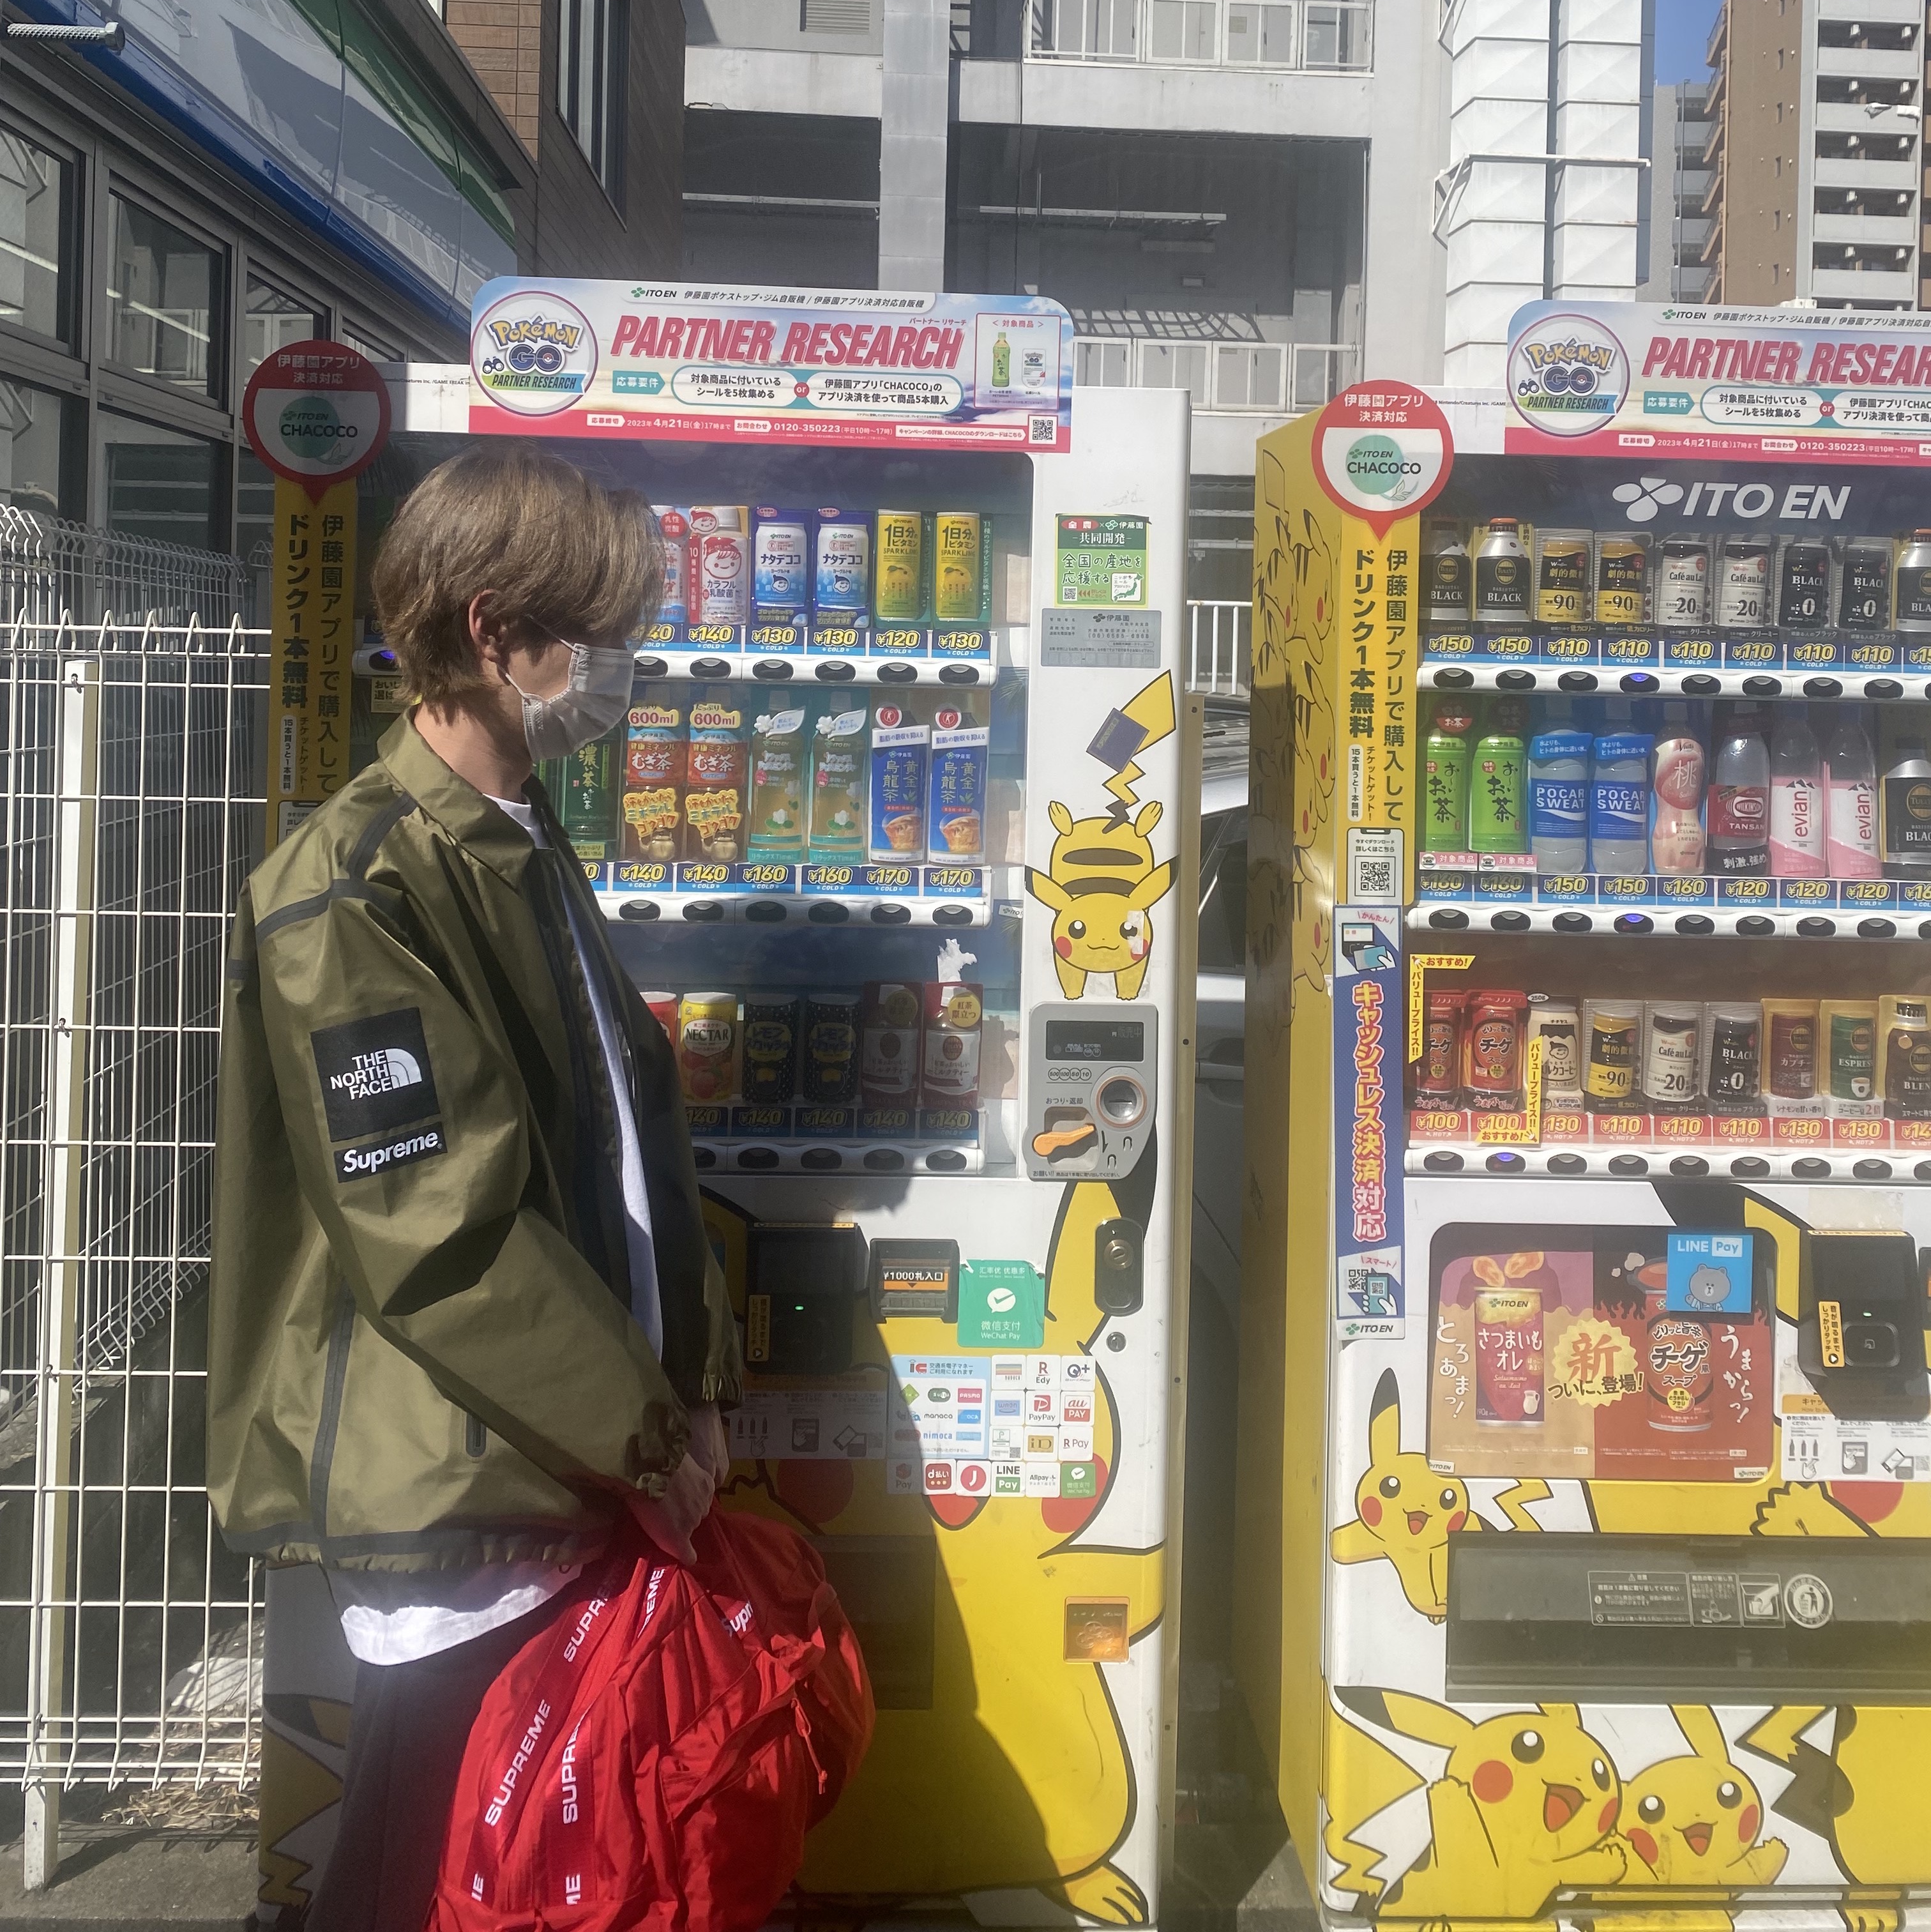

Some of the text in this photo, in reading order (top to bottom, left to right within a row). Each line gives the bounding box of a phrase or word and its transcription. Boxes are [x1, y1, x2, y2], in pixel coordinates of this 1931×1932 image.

[684, 290, 806, 304] 伊藤園ポケストップ・ジム自販機
[814, 295, 925, 308] 伊藤園アプリ決済対応自販機
[1713, 312, 1830, 324] 伊藤園ポケストップ・ジム自販機
[1838, 317, 1931, 328] 伊藤園アプリ決済対応自
[491, 316, 580, 347] Pokémon
[610, 315, 965, 370] PARTNER RESEARCH
[277, 354, 360, 369] 伊藤園アプリ
[509, 345, 563, 372] GO
[1526, 338, 1613, 370] Pokémon
[293, 372, 344, 384] 決済対応
[492, 374, 577, 390] PARTNER RESEARCH
[616, 376, 658, 388] 応募要件
[690, 373, 782, 386] 対象商品に付いている
[824, 379, 943, 392] 伊藤園アプリ「CHACOCO」の
[1543, 365, 1595, 393] GO
[697, 386, 775, 399] シールを5枚集める
[818, 392, 949, 405] アプリ決済を使って商品5本購入
[1344, 394, 1424, 407] 伊藤園アプリ
[1719, 393, 1807, 406] 対象商品に付いている
[1527, 395, 1609, 410] PARTNER RESEARCH
[1647, 397, 1688, 407] 応募要件
[1359, 411, 1407, 422] 決済対応
[1725, 407, 1801, 418] シールを5枚集める
[281, 424, 358, 438] CHACOCO
[736, 422, 768, 430] お問合わせ
[774, 422, 840, 433] 0120-350223
[1800, 443, 1865, 452] 0120-350223
[1347, 462, 1421, 475] CHACOCO
[1682, 482, 1851, 520] ITO EN
[1079, 533, 1126, 544] 共同開発
[761, 554, 801, 565] ナタデココ
[822, 554, 862, 565] ナタデココ
[1062, 553, 1142, 568] 全国の産地を
[707, 580, 736, 589] カラフル
[1062, 571, 1109, 585] 応援する
[710, 589, 733, 598] 乳酸菌
[1431, 591, 1463, 600] BLACK
[1487, 593, 1522, 602] BLACK
[1554, 595, 1575, 610] 90
[1612, 595, 1633, 611] 90
[1675, 597, 1696, 613] 20
[1737, 600, 1757, 616] 20
[1802, 597, 1815, 616] 0
[1863, 599, 1877, 618] 0
[282, 514, 310, 709] ドリンク1本無料
[690, 625, 733, 643] ¥140
[753, 627, 796, 644] ¥130
[814, 630, 857, 646] ¥130
[877, 631, 920, 646] ¥120
[939, 633, 982, 649] ¥130
[1349, 549, 1375, 738] ドリンク1本無料
[1430, 635, 1473, 651] ¥150
[1489, 637, 1531, 653] ¥150
[1549, 639, 1589, 655] ¥110
[1610, 640, 1650, 657] ¥110
[1672, 641, 1713, 658] ¥110
[317, 514, 344, 794] 伊藤園アプリで購入して
[1734, 643, 1775, 660] ¥110
[1794, 644, 1835, 660] ¥110
[1852, 646, 1893, 663] ¥110
[1383, 549, 1408, 821] 伊藤園アプリで購入して
[630, 713, 674, 724] 600ml
[694, 713, 735, 725] 600ml
[1444, 718, 1464, 727] お茶
[579, 743, 600, 787] 濃い茶
[632, 752, 674, 771] むぎ茶
[693, 754, 736, 772] むぎ茶
[903, 759, 918, 788] 黄金
[960, 761, 976, 789] 黄金
[1674, 759, 1697, 789] 桃
[1351, 749, 1360, 818] 15本買うと1本無料
[1367, 746, 1375, 821] チケットゲット!
[1429, 775, 1456, 823] お茶
[1487, 775, 1516, 823] お茶
[1536, 798, 1585, 809] SWEAT
[1597, 800, 1646, 810] SWEAT
[627, 802, 670, 821] ミネラル
[690, 803, 732, 822] ミネラル
[1791, 790, 1808, 837] evian
[1855, 793, 1872, 840] evian
[1723, 855, 1766, 869] 刺激、強め
[621, 863, 665, 882] ¥140
[683, 865, 729, 883] ¥140
[744, 865, 787, 883] ¥160
[809, 867, 852, 885] ¥160
[868, 868, 911, 886] ¥170
[931, 869, 974, 888] ¥170
[1421, 874, 1464, 890] ¥160
[1481, 875, 1524, 892] ¥160
[1545, 876, 1587, 893] ¥150
[1606, 879, 1647, 894] ¥150
[1665, 879, 1706, 895] ¥160
[1727, 881, 1769, 897] ¥120
[1788, 883, 1829, 899] ¥120
[1847, 884, 1889, 900] ¥120
[1426, 957, 1468, 966] おすすめ!
[1412, 971, 1421, 1056] バリュープライス!!
[685, 1028, 729, 1042] NECTAR
[1480, 1037, 1513, 1053] チゲ
[352, 1050, 386, 1070] THE
[330, 1063, 391, 1090] NORTH
[1607, 1071, 1626, 1087] 90
[1664, 1074, 1685, 1091] 20
[1730, 1072, 1744, 1090] 0
[349, 1077, 393, 1100] FACE
[1529, 1044, 1540, 1127] バリュープライス!!
[1353, 982, 1384, 1240] キャッシュレス決済対応
[1418, 1114, 1460, 1130] ¥100
[1602, 1117, 1642, 1132] ¥110
[1662, 1118, 1703, 1135] ¥110
[1720, 1120, 1761, 1136] ¥110
[1780, 1122, 1822, 1136] ¥130
[1840, 1122, 1881, 1137] ¥130
[1481, 1132, 1523, 1141] おすすめ!
[343, 1131, 439, 1173] Supreme
[1677, 1240, 1739, 1254] LINE Pay
[884, 1272, 944, 1281] ¥1000札入口
[981, 1321, 1020, 1331] 微信支付
[1360, 1325, 1393, 1333] ITO EN
[1478, 1328, 1543, 1350] さつまいも
[1496, 1350, 1524, 1371] オレ
[1566, 1332, 1623, 1382] 新
[1547, 1372, 1645, 1400] ついに、登場!
[1662, 1375, 1698, 1387] スープ
[996, 1466, 1020, 1475] LINE
[999, 1480, 1017, 1489] Pay
[485, 1699, 551, 1827] SUPREME
